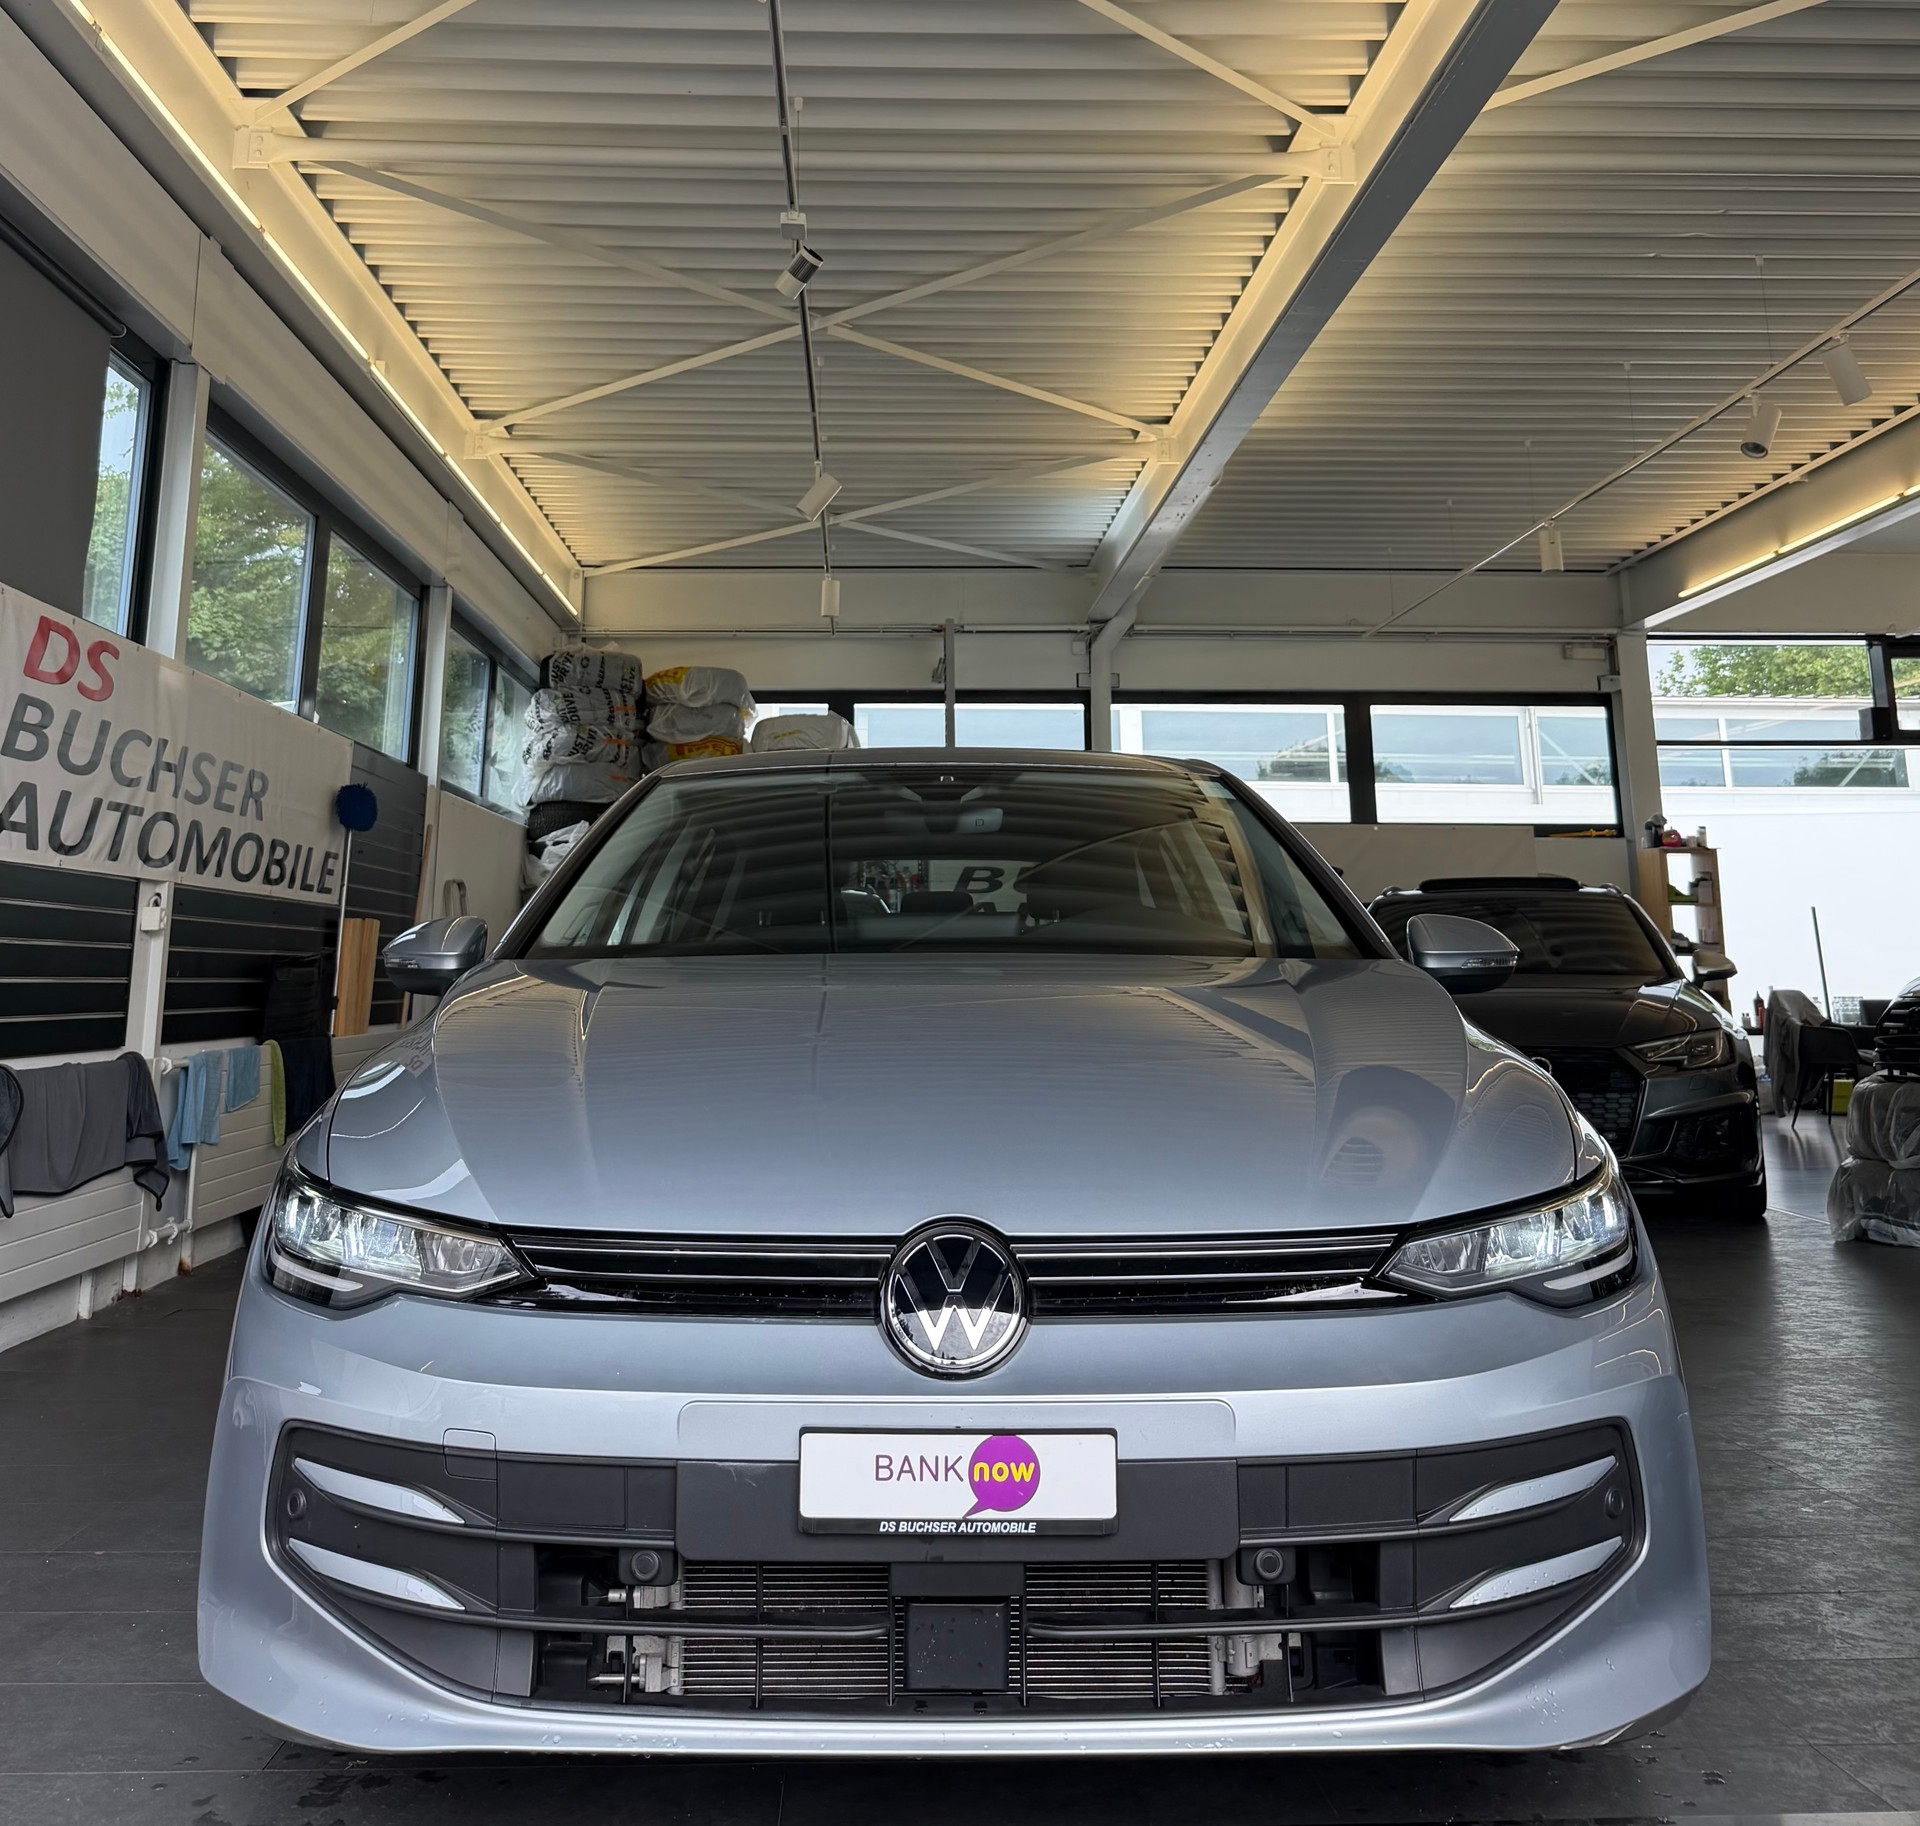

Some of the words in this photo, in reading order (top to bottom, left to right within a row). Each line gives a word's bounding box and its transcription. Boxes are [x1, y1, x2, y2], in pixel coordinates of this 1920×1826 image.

[23, 615, 121, 702] DS
[1, 693, 271, 821] BUCHSER
[0, 781, 340, 895] AUTOMOBILE
[893, 1228, 1018, 1354] VW
[875, 1454, 964, 1482] BANK
[972, 1461, 1036, 1484] now
[879, 1521, 897, 1533] DS
[898, 1521, 957, 1533] BUCHSER
[957, 1521, 1037, 1533] AUTOMOBILE
